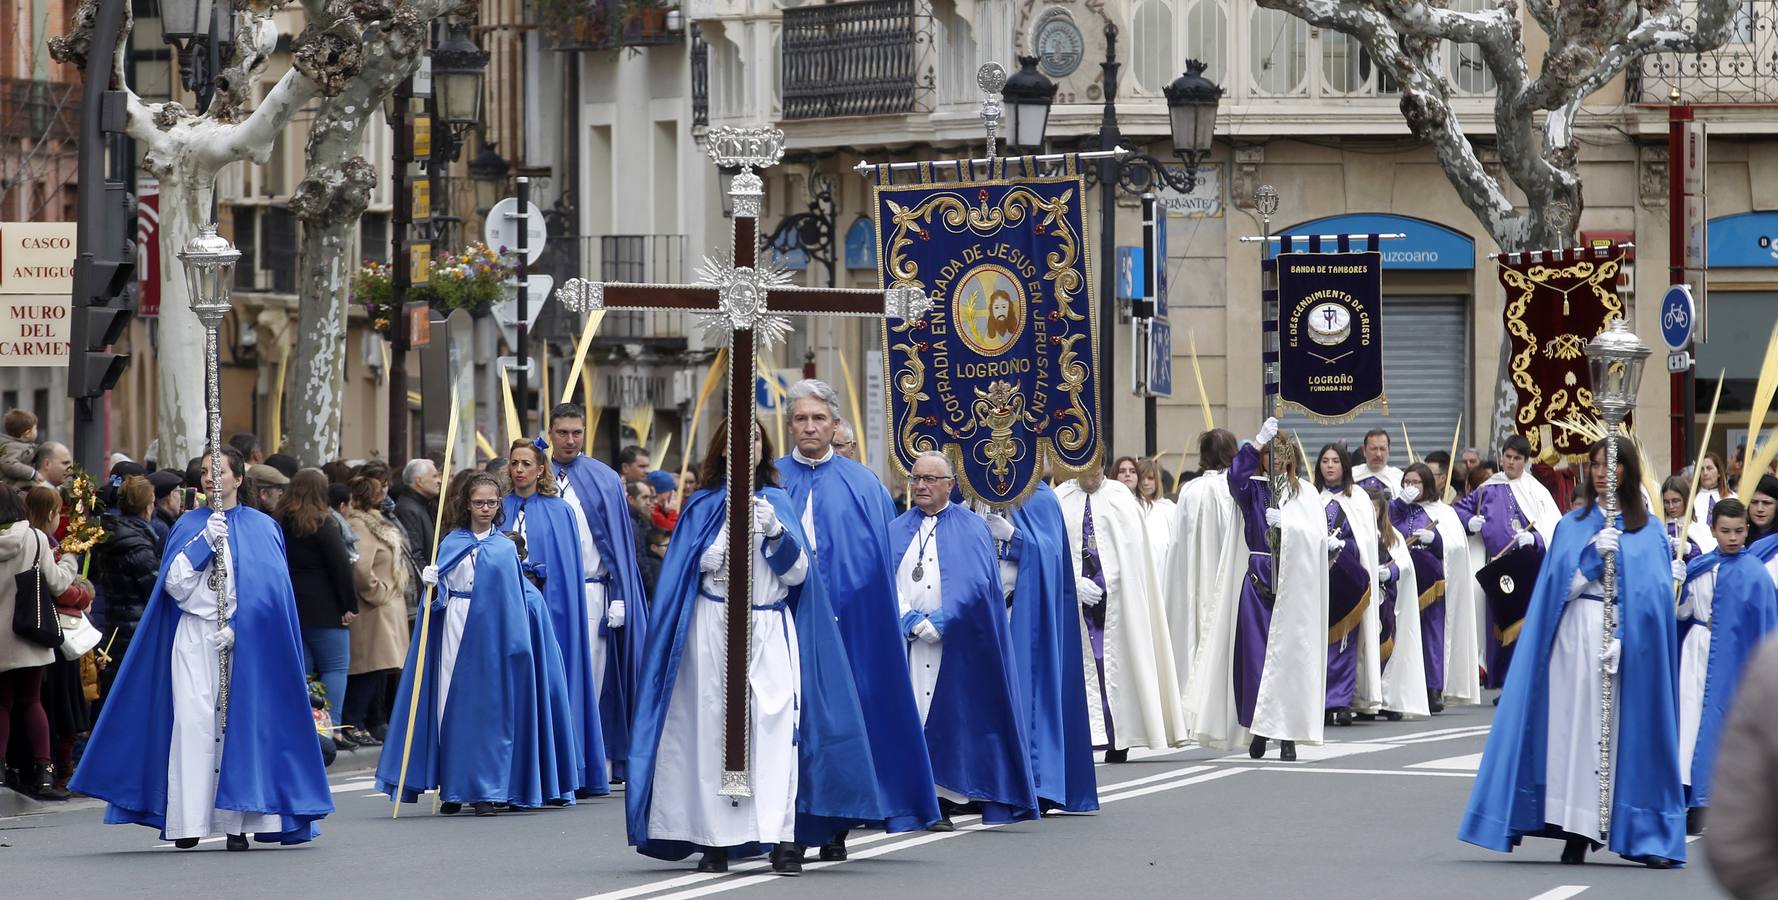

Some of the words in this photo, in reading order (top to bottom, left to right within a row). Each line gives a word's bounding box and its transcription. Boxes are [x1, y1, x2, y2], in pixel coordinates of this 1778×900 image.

[722, 138, 767, 158] INRI
[21, 237, 71, 249] CASCO
[962, 243, 984, 264] DE
[987, 243, 1037, 278] JESUS
[1290, 265, 1316, 274] BANDA
[1316, 265, 1327, 274] DE
[1328, 265, 1368, 274] TAMBORES
[1028, 280, 1043, 304] EN
[10, 305, 66, 319] MURO
[1289, 289, 1352, 335] DESCENDIMIENTO
[1351, 299, 1364, 312] DE
[20, 323, 56, 338] DEL
[1360, 312, 1370, 346] CRISTO
[1290, 336, 1298, 347] EL
[956, 357, 1031, 379] LOGROÑO
[1031, 309, 1049, 414] JERUSALEN
[933, 340, 965, 422] COFRADIA
[1308, 373, 1354, 385] LOGROÑO
